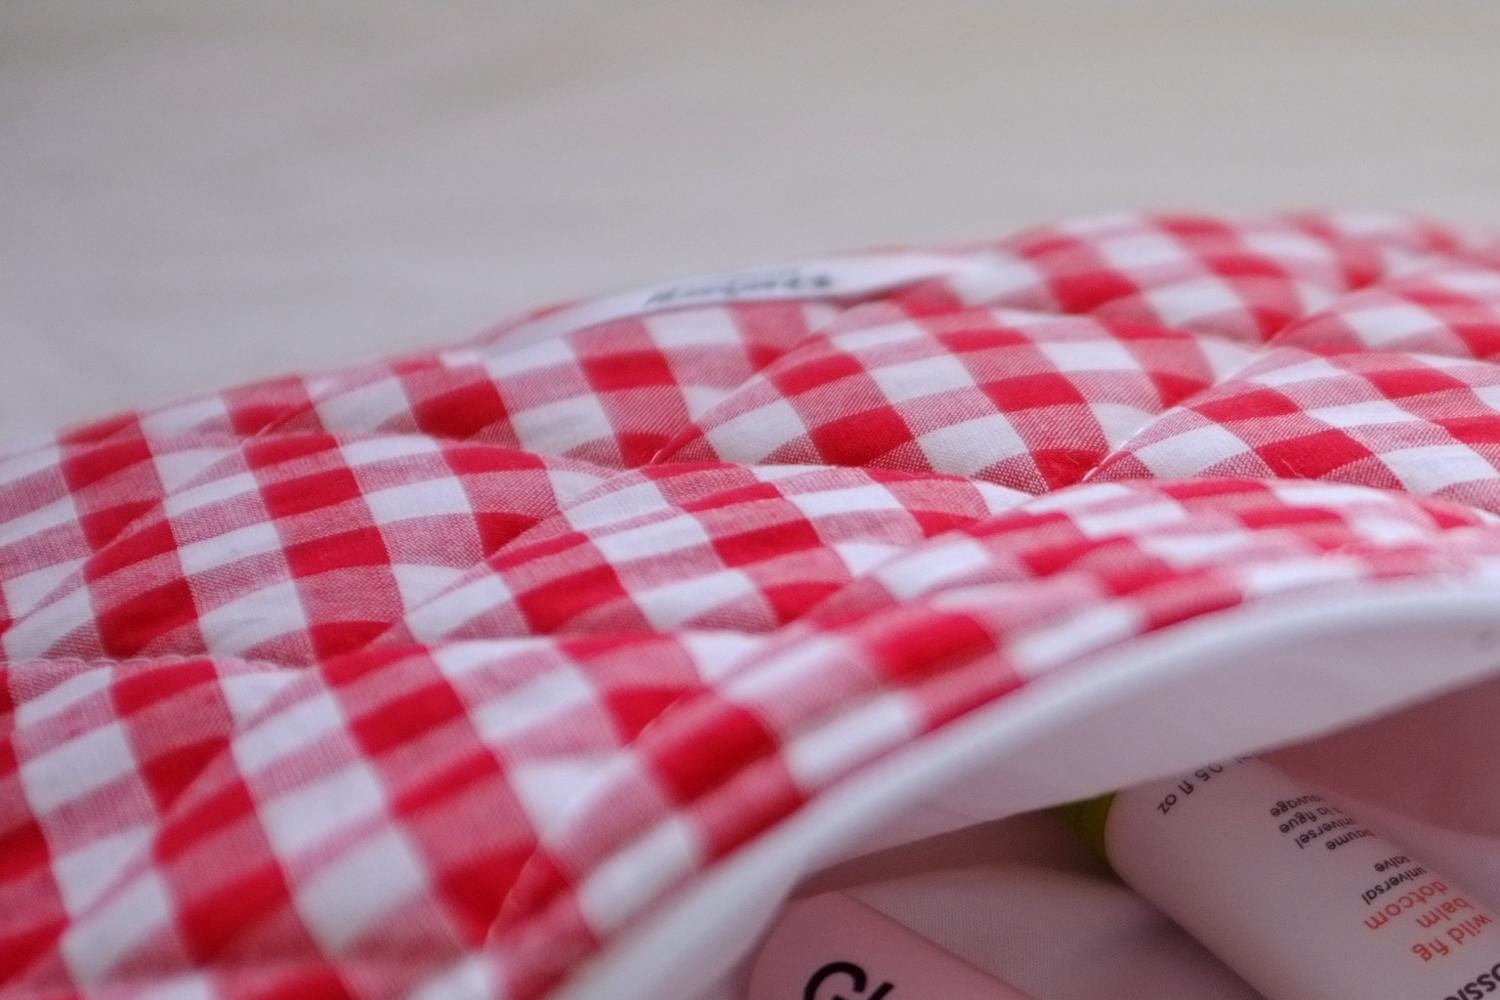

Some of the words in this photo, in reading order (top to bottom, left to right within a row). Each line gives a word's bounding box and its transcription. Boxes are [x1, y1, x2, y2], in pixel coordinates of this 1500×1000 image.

[1178, 780, 1195, 796] fl
[1157, 793, 1177, 815] oz
[1279, 810, 1318, 834] figue
[1361, 866, 1427, 905] universal
[1363, 880, 1448, 930] dotcom
[1416, 897, 1474, 928] balm
[1447, 913, 1493, 945] wild
[1411, 938, 1449, 962] fig
